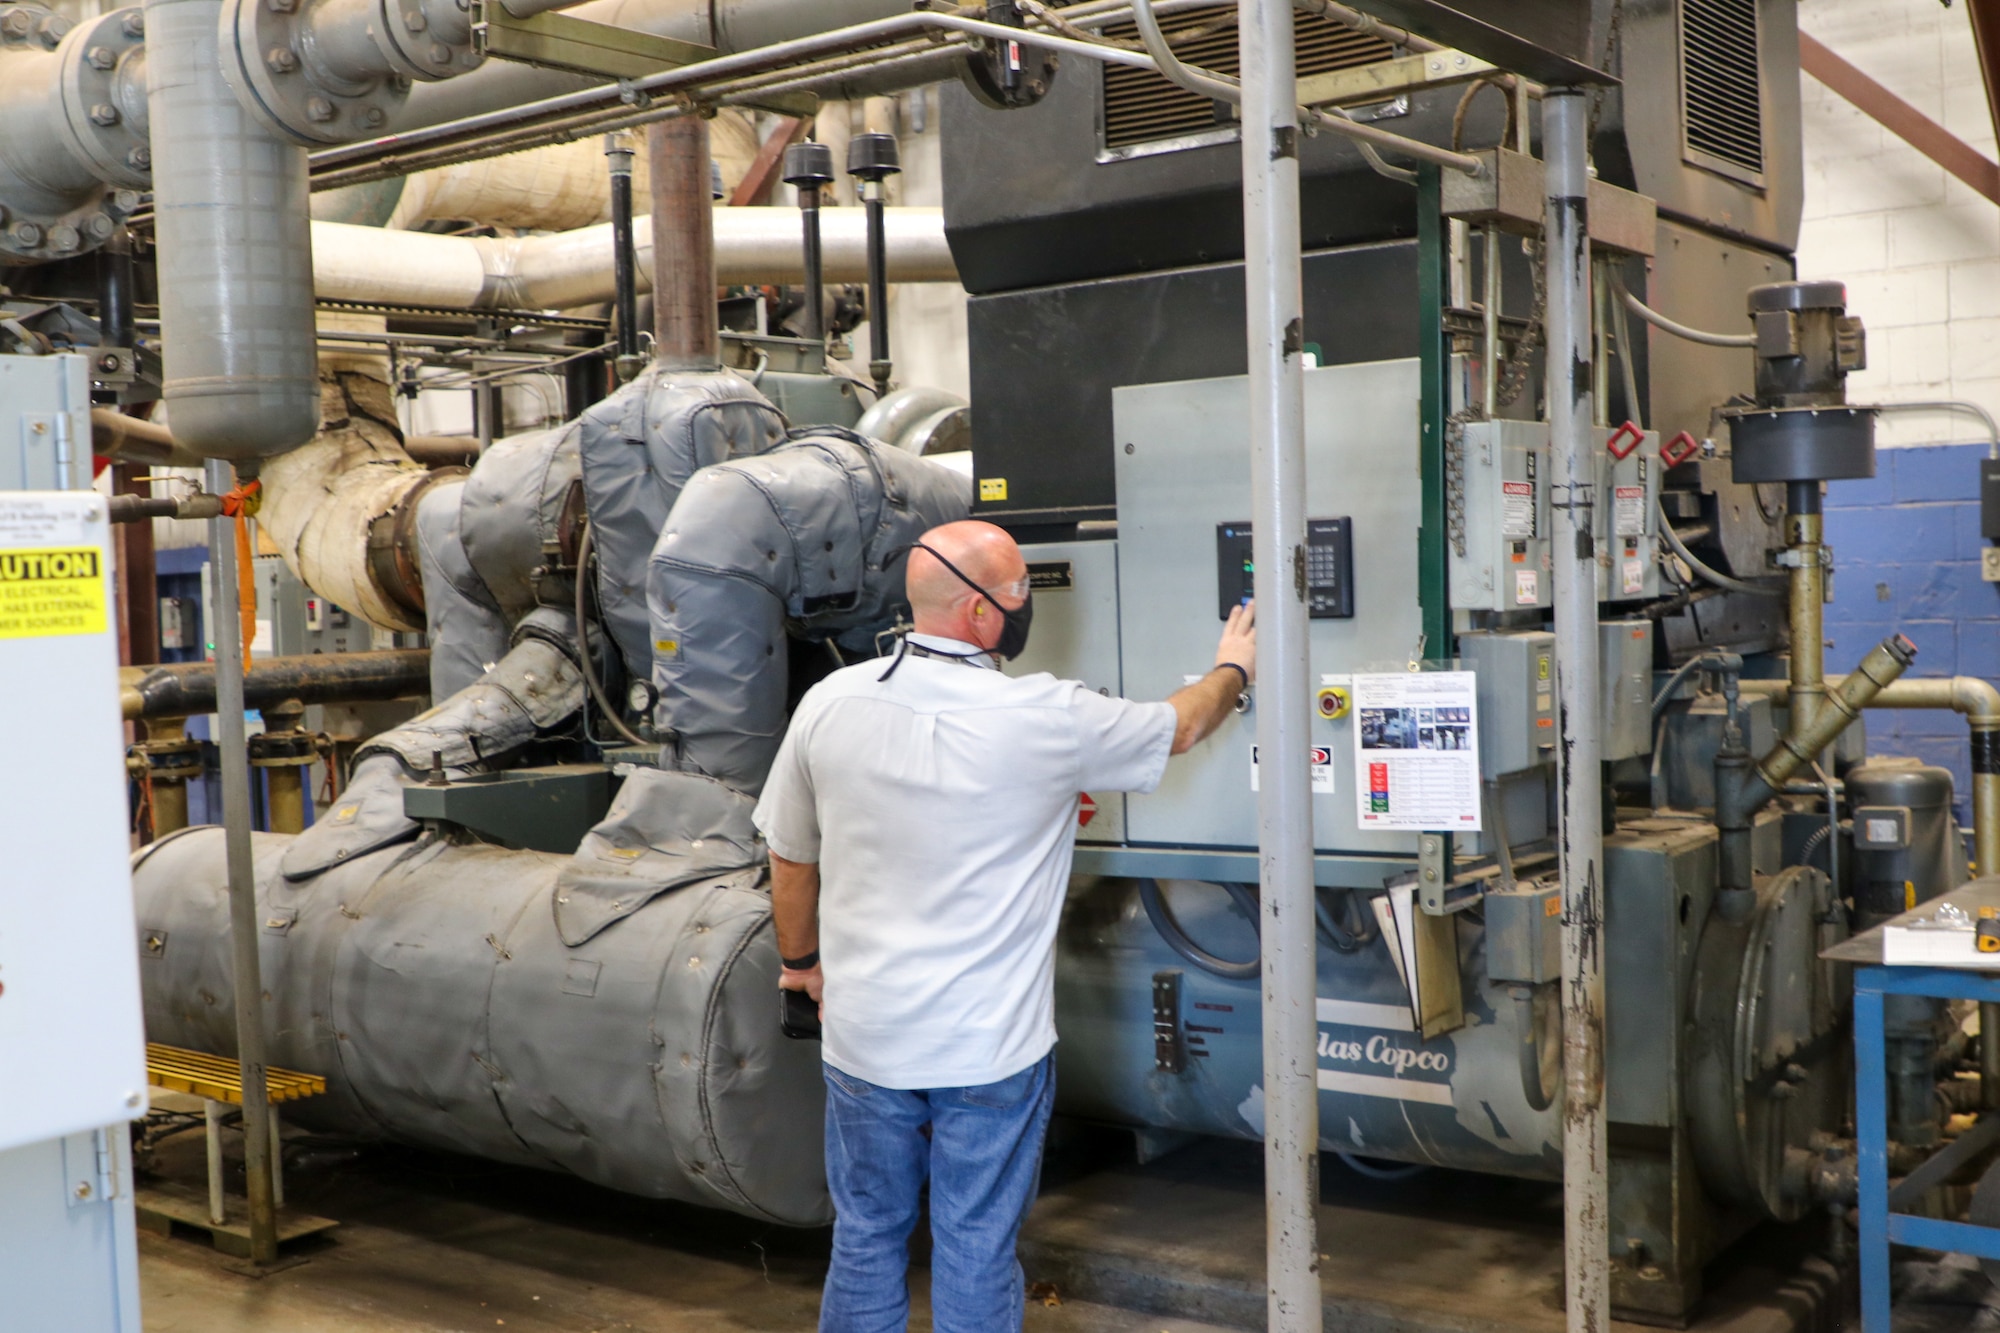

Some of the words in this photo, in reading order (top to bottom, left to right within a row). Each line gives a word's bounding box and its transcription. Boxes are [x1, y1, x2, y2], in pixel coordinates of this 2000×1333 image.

[0, 552, 93, 580] UTION
[5, 585, 82, 599] ELECTRICAL
[33, 600, 97, 613] EXTERNAL
[26, 615, 85, 629] SOURCES
[1317, 1031, 1363, 1061] las
[1365, 1035, 1449, 1074] Copco
